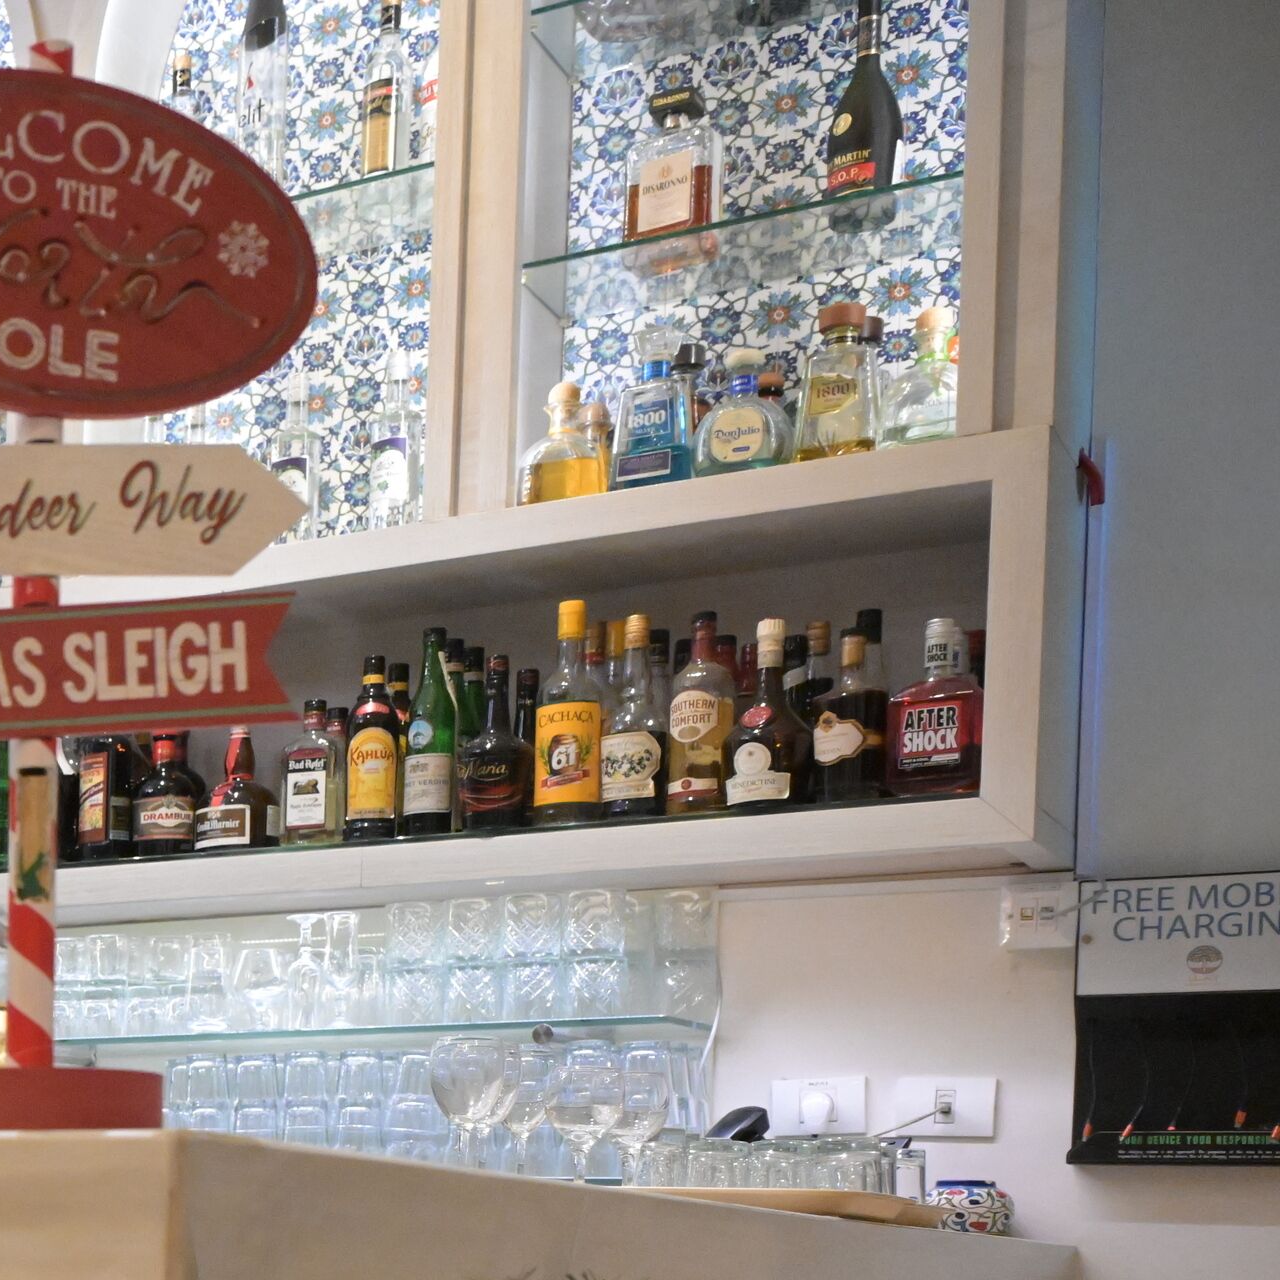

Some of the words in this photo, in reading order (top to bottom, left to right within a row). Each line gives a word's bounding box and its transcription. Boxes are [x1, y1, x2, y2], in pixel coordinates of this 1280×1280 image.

[239, 98, 264, 128] elit
[833, 149, 870, 165] MARTIN
[56, 175, 118, 220] THE
[642, 175, 688, 197] DISARONNO
[815, 382, 850, 399] 1800
[627, 409, 667, 429] 1800
[120, 460, 247, 544] Way
[927, 643, 948, 653] AFTER
[927, 652, 948, 663] SHOCK
[62, 620, 248, 702] SLEIGH
[671, 699, 716, 714] SOUTHERN
[671, 713, 712, 728] COMFORT
[903, 706, 957, 732] AFTER
[903, 728, 957, 753] SHOCK
[551, 742, 577, 770] 61
[1092, 886, 1175, 914] FREE
[1187, 881, 1280, 910] MOB
